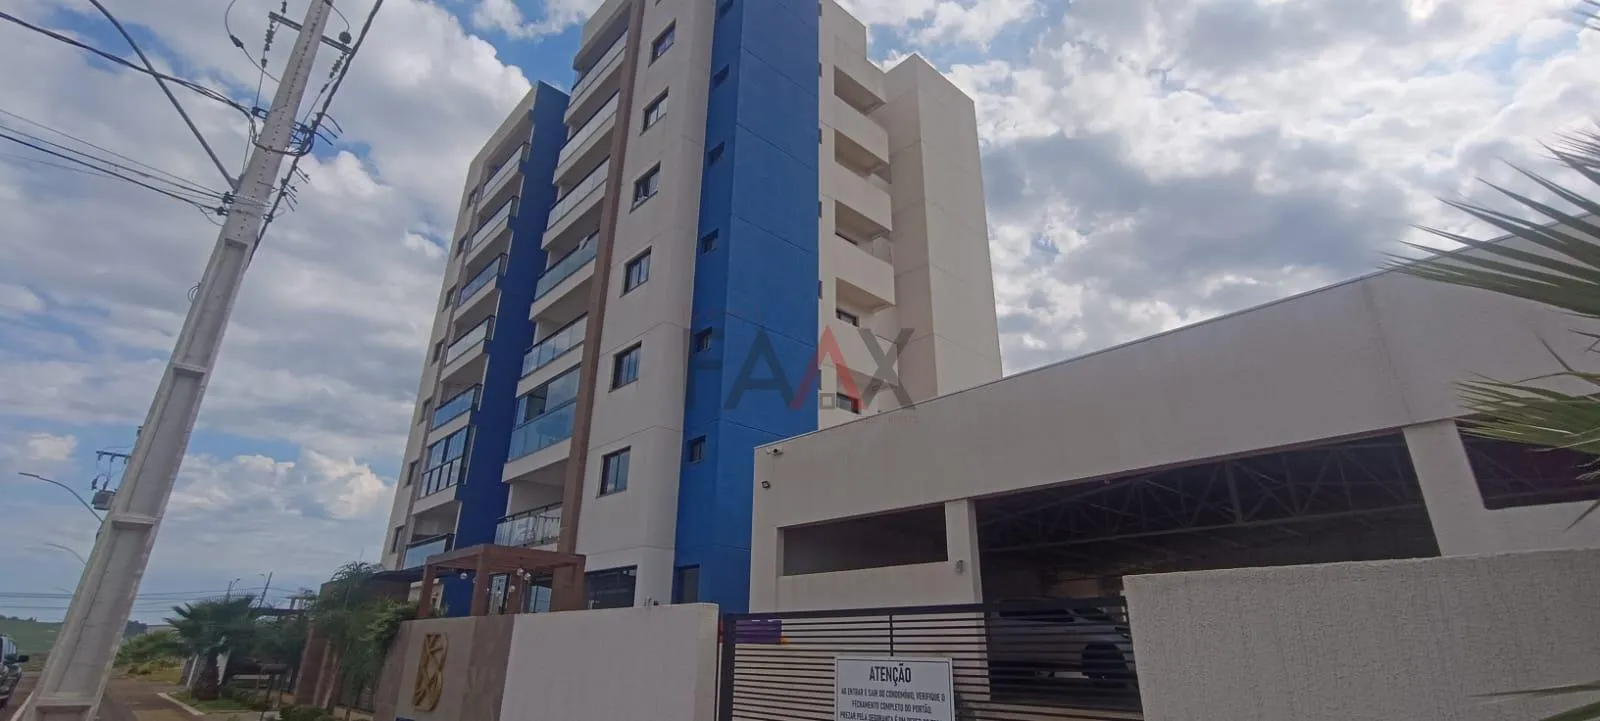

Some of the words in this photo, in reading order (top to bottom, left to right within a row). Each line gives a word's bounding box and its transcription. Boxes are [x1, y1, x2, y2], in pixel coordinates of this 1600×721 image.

[869, 663, 912, 686] ATENÇÃO
[848, 688, 864, 696] ENTRAR
[880, 702, 904, 712] COMPLETO
[904, 704, 911, 712] DO
